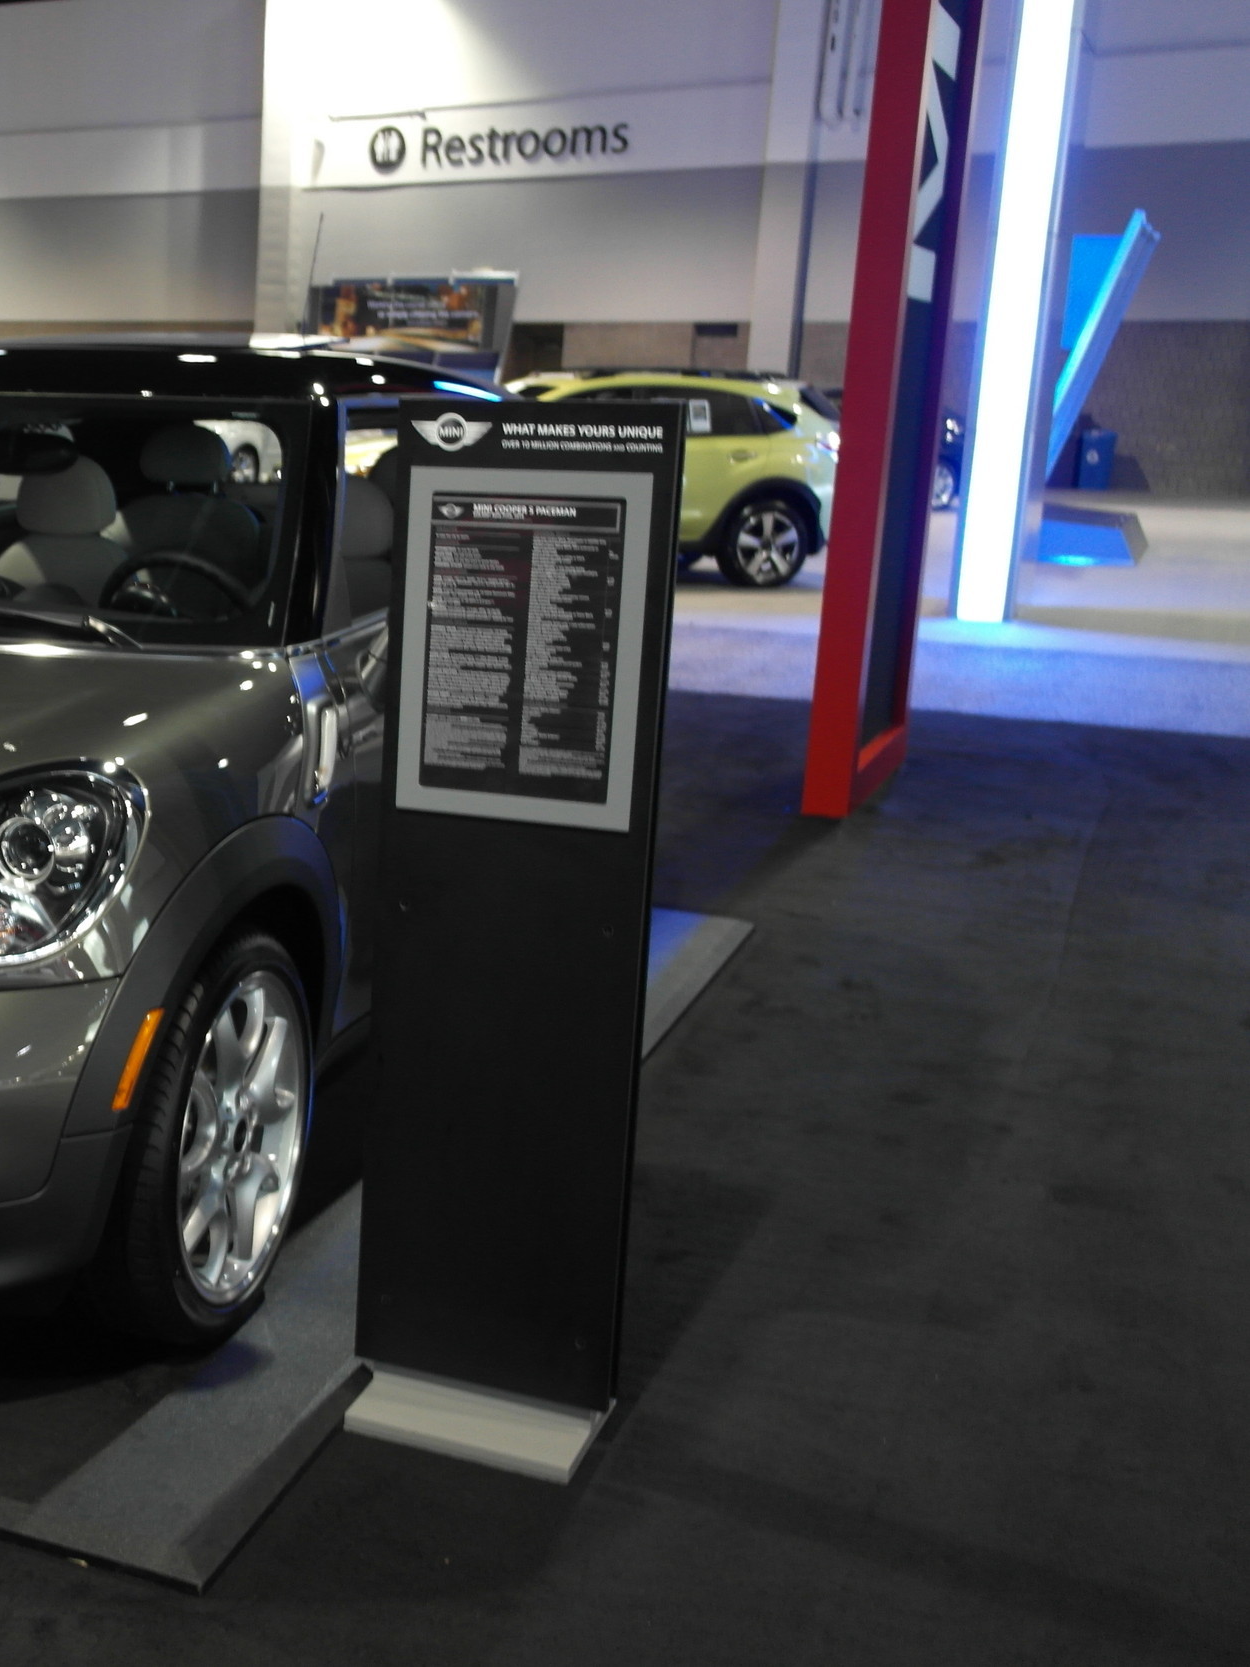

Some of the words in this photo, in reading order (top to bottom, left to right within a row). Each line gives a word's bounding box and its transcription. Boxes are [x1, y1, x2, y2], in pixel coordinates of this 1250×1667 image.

[420, 121, 630, 169] Restrooms
[439, 425, 464, 438] MINI
[501, 422, 535, 436] WHAT
[537, 423, 576, 437] MAKES
[577, 424, 616, 438] YOURS
[617, 425, 663, 440] UNIQUE
[501, 439, 520, 450] OVER
[530, 440, 559, 451] MILLION
[560, 440, 612, 452] COMBINATIONS
[625, 442, 663, 454] COUNTING
